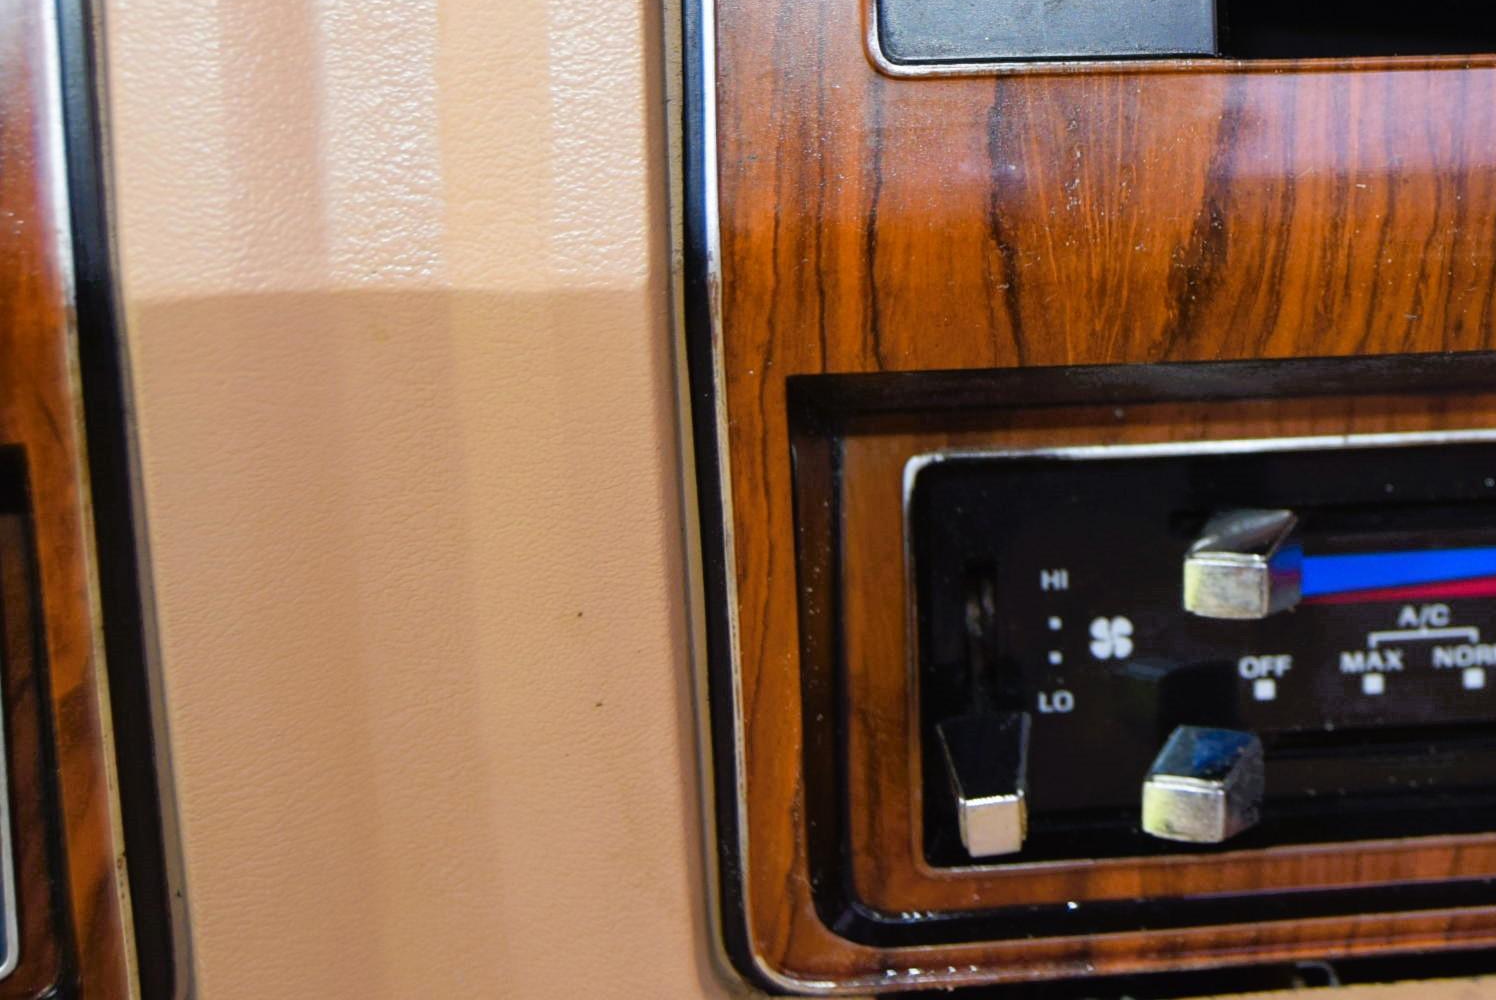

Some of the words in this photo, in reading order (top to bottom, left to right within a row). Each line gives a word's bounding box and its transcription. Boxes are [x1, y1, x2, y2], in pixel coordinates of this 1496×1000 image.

[1040, 568, 1069, 591] HI
[1399, 603, 1450, 627] A/C
[1239, 656, 1291, 679] OFF
[1340, 648, 1404, 674] MAX
[1038, 689, 1075, 713] LO
